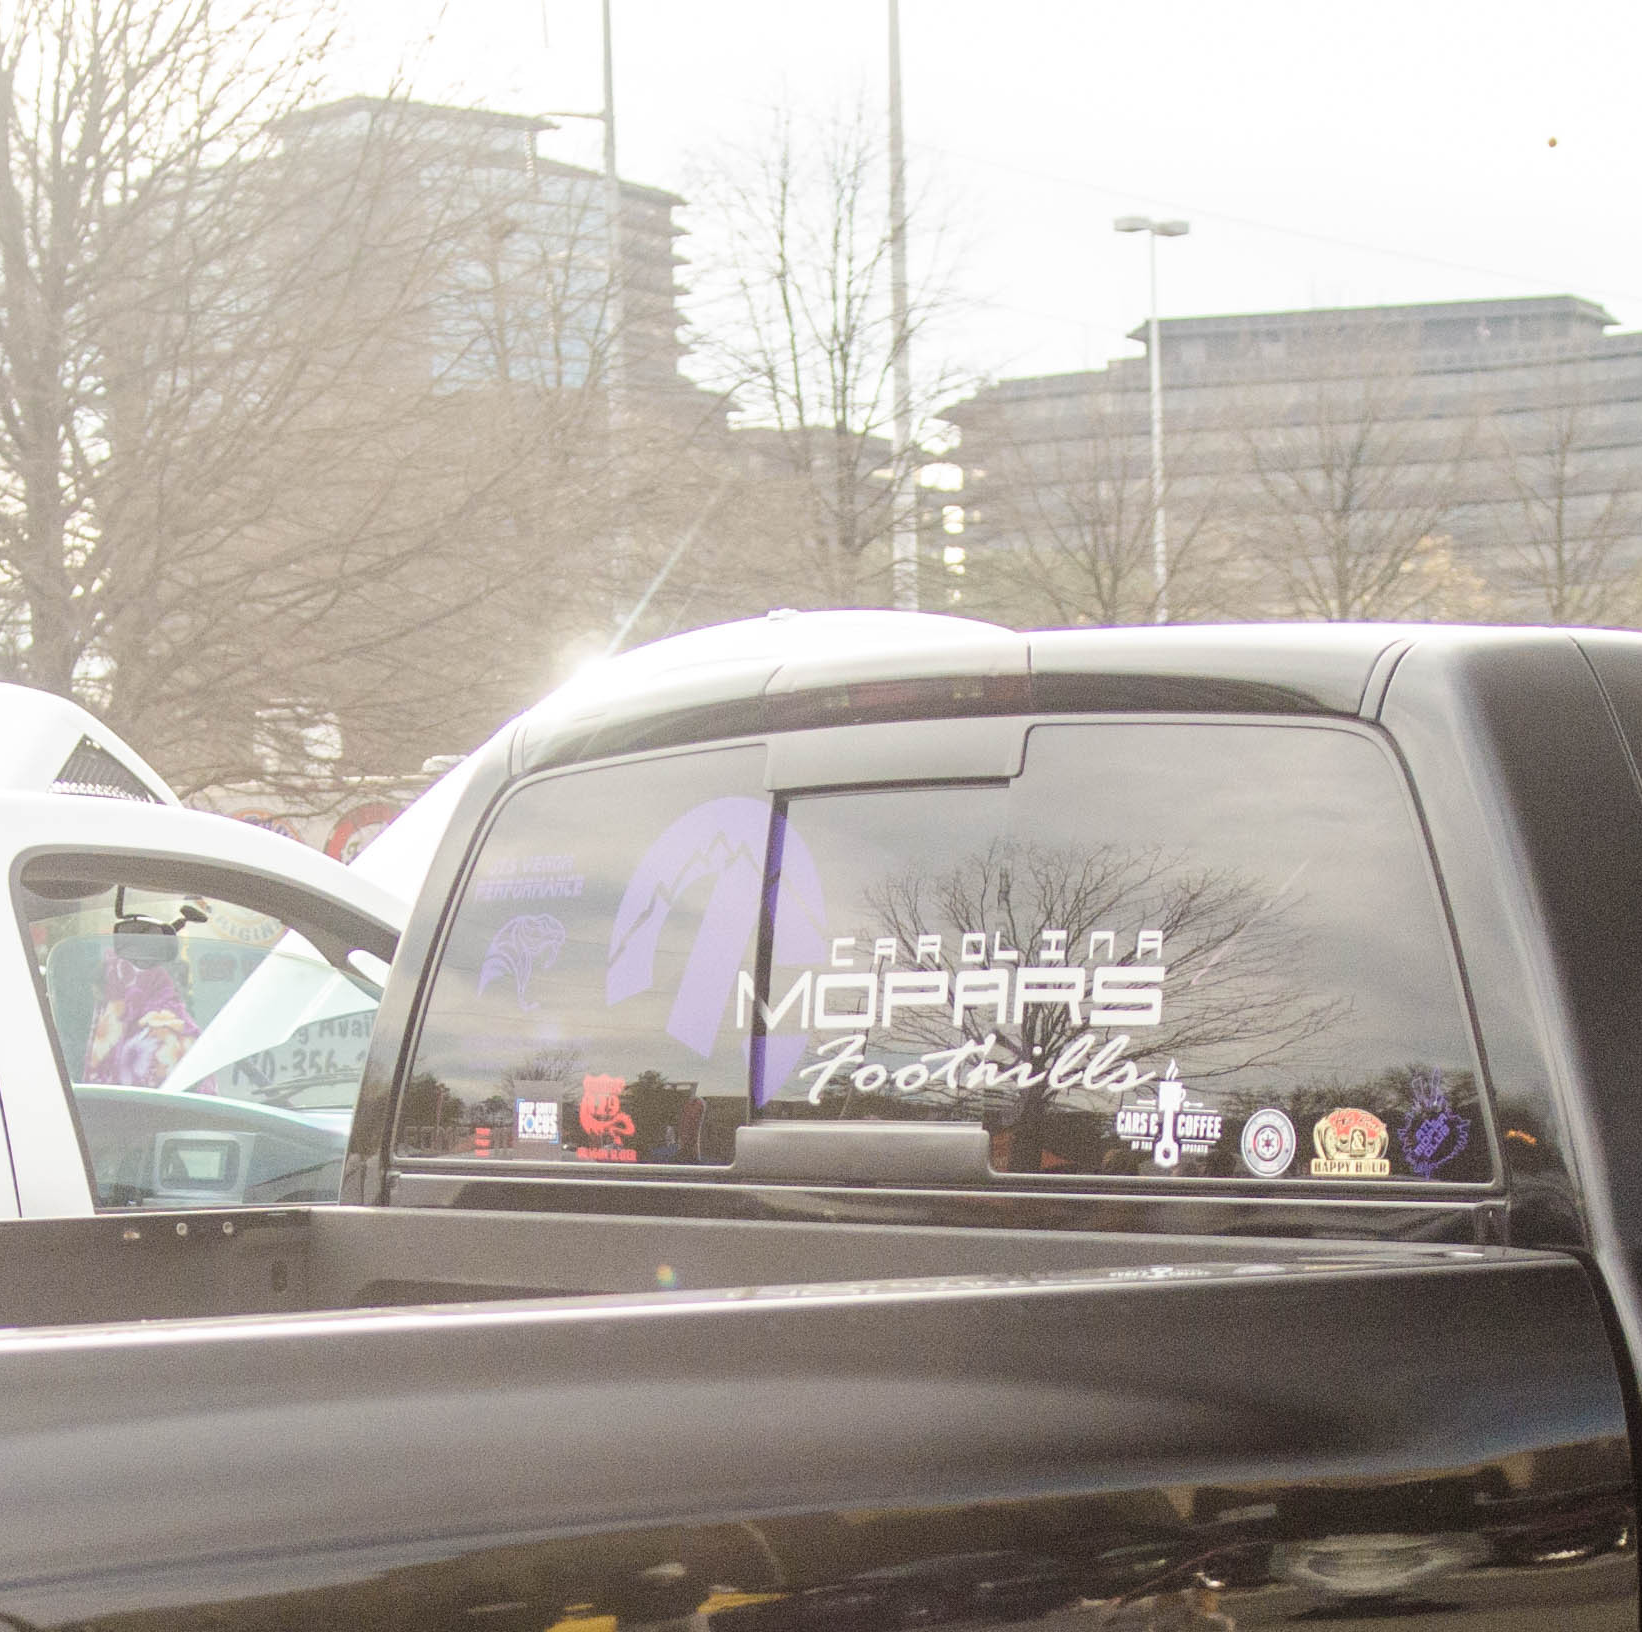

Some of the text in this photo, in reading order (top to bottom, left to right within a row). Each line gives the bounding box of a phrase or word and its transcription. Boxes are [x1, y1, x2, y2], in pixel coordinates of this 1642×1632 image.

[831, 930, 1163, 967] CAROLINA
[736, 966, 1165, 1030] MOPARS
[799, 1032, 1157, 1105] Foothills
[518, 1113, 558, 1134] FOCUS
[1117, 1111, 1148, 1136] CARS
[1177, 1114, 1223, 1139] COFFEE
[1314, 1161, 1351, 1173] HAPPY
